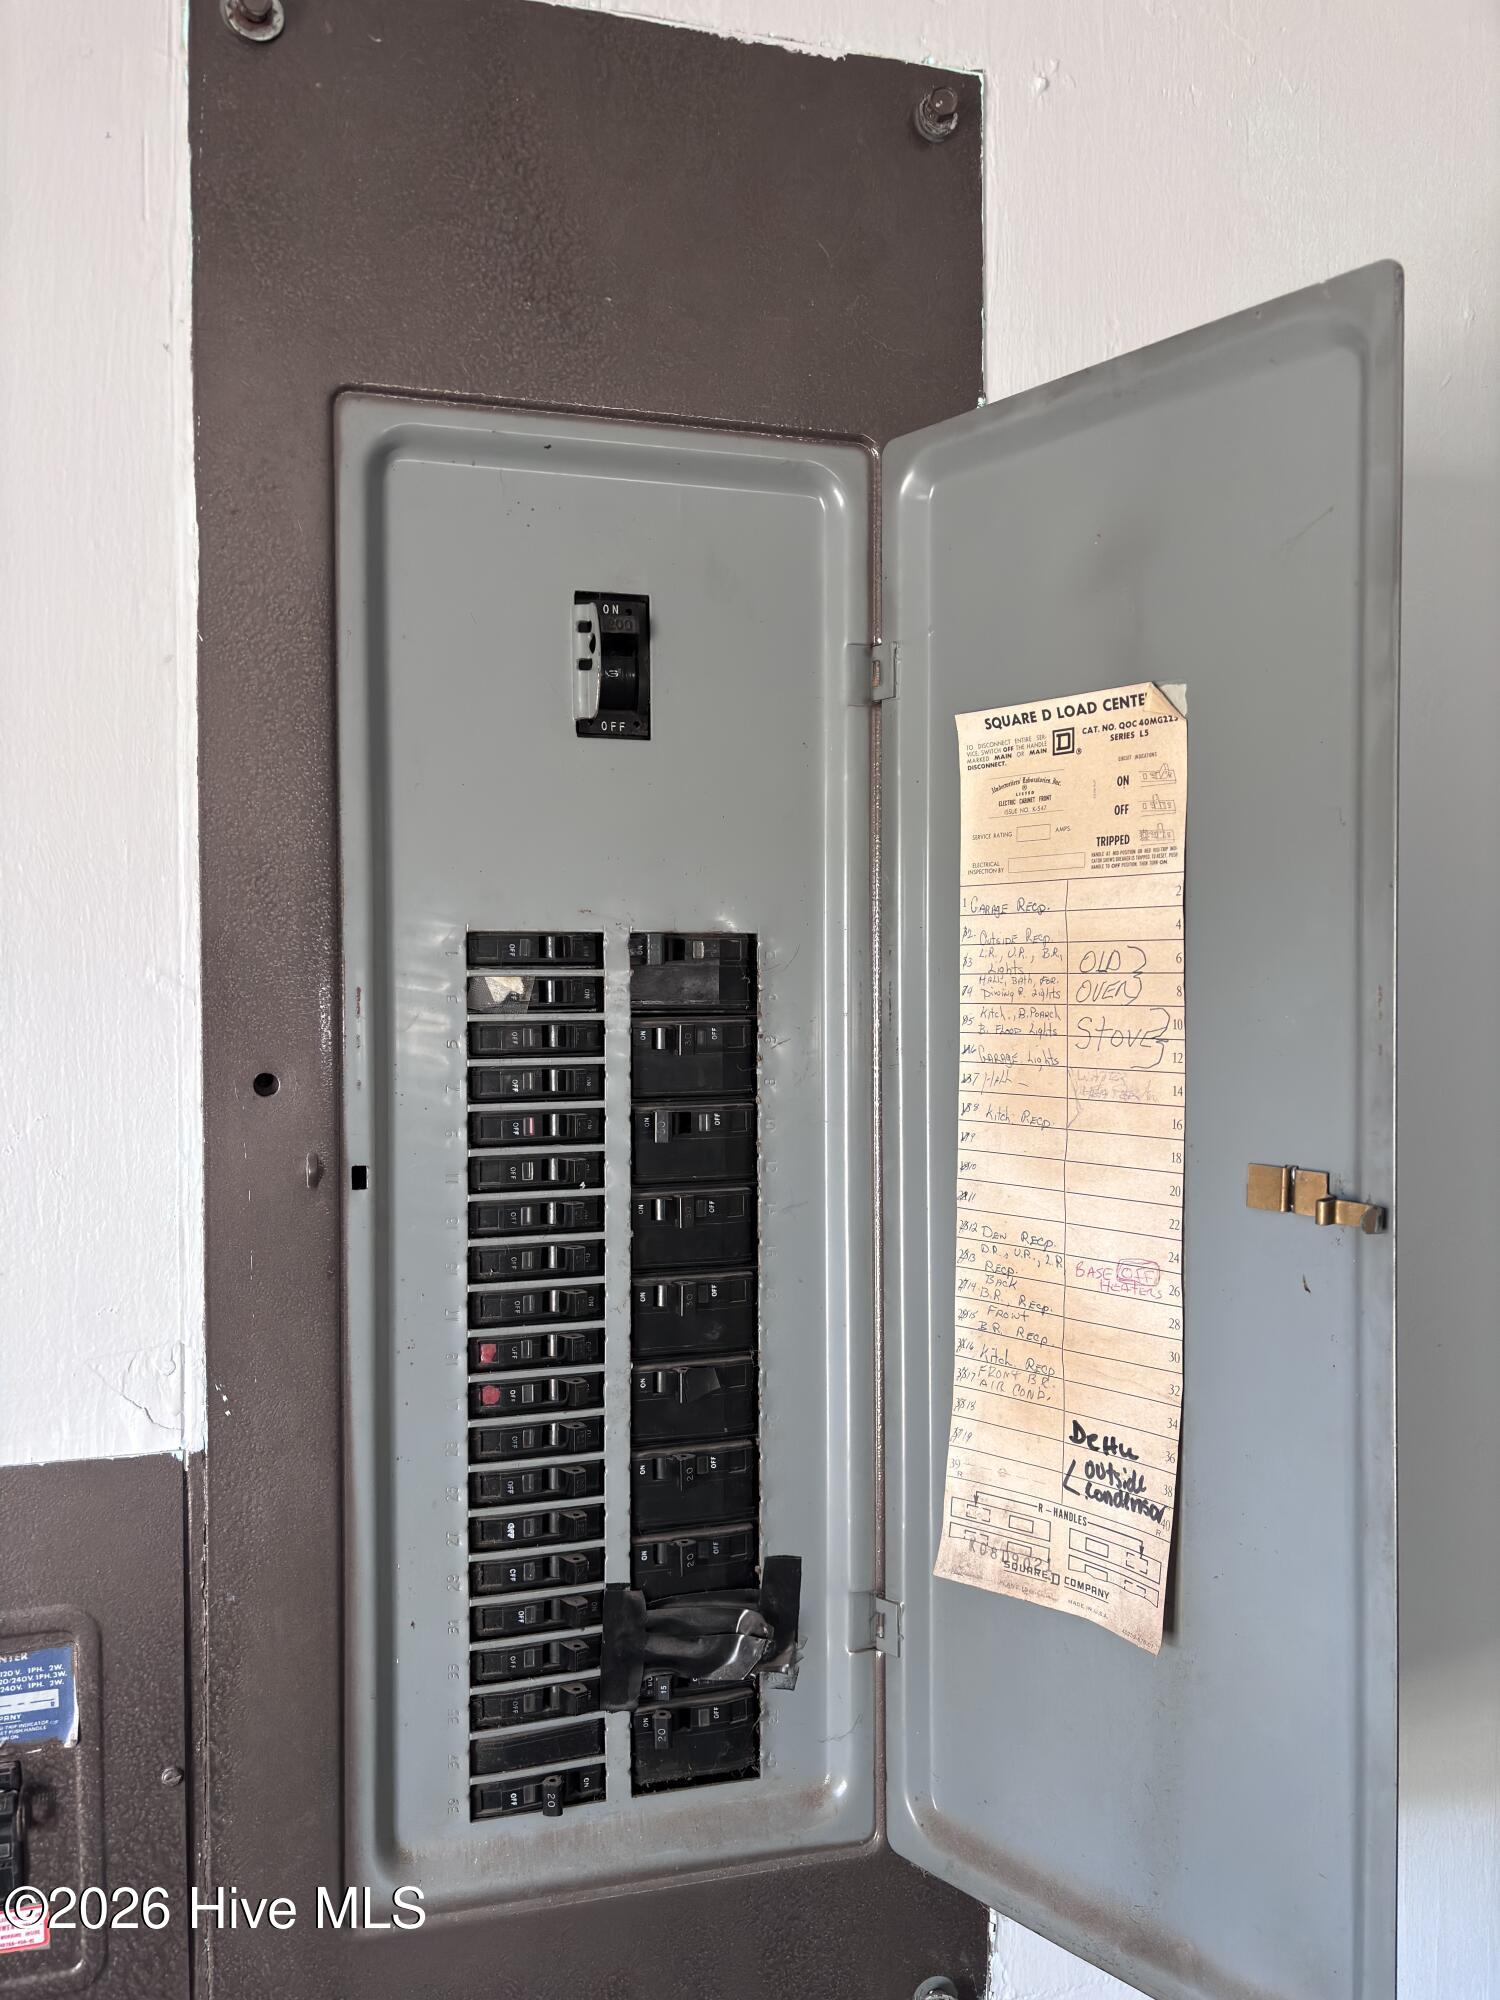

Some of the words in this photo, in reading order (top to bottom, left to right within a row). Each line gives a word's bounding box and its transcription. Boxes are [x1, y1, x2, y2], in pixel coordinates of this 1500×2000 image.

[602, 604, 619, 614] ON
[984, 711, 1037, 731] SQUARE
[1042, 709, 1052, 722] D
[1056, 701, 1098, 719] LOAD
[1102, 693, 1147, 712] CENTE
[601, 721, 626, 731] OFF
[1082, 725, 1100, 735] CAT.
[1102, 723, 1116, 732] NO.
[1118, 720, 1138, 730] QOC
[1110, 731, 1135, 742] SERIES
[1139, 729, 1149, 738] L5
[978, 739, 1011, 749] DISCONNECT
[1014, 736, 1032, 744] ENTIRE
[981, 747, 1001, 756] SWITCH
[1026, 741, 1047, 750] HANDLE
[967, 756, 990, 764] MARKED
[994, 752, 1012, 761] MAIN
[1029, 747, 1048, 756] MAIN
[967, 760, 1007, 771] DISCONNECT.
[1116, 775, 1130, 787] ON
[998, 799, 1016, 807] ELECTRIC
[1114, 804, 1129, 816] OFF
[972, 832, 992, 841] SERVICE
[993, 831, 1013, 839] RATING
[1096, 834, 1130, 847] TRIPPED
[972, 861, 1000, 869] ELECTRICAL
[968, 868, 995, 876] INSPECTION
[1175, 885, 1182, 896] 2
[1175, 919, 1182, 930] 4
[508, 943, 516, 957] OFF
[1079, 950, 1121, 974] OLD
[1175, 953, 1182, 963] 6
[1176, 986, 1182, 997] 8
[1173, 1018, 1183, 1030] 10
[511, 1031, 519, 1045] OFF
[640, 1030, 646, 1040] ON
[1172, 1052, 1183, 1063] 12
[511, 1079, 519, 1093] OFF
[1172, 1085, 1183, 1097] 14
[644, 1117, 650, 1127] ON
[1172, 1118, 1183, 1130] 16
[512, 1122, 520, 1136] OFF
[1171, 1152, 1182, 1163] 18
[1169, 1185, 1181, 1197] 20
[638, 1204, 644, 1214] ON
[1168, 1218, 1180, 1231] 22
[1168, 1252, 1180, 1263] 24
[1075, 1261, 1113, 1280] BASE
[1168, 1285, 1180, 1296] 26
[640, 1292, 646, 1302] ON
[1168, 1318, 1180, 1330] 28
[1168, 1351, 1180, 1364] 30
[640, 1378, 646, 1388] ON
[1168, 1384, 1180, 1396] 32
[1167, 1417, 1178, 1429] 34
[951, 1458, 960, 1469] 39
[1164, 1452, 1176, 1463] 36
[639, 1464, 646, 1475] ON
[686, 1467, 694, 1481] 20
[1163, 1486, 1173, 1497] 38
[1038, 1503, 1043, 1513] R
[1053, 1508, 1088, 1527] HANDLES
[641, 1550, 647, 1561] ON
[687, 1553, 694, 1568] 20
[1064, 1576, 1110, 1599] COMPANY
[509, 1655, 517, 1669] OFF
[660, 1685, 667, 1694] 15
[643, 1717, 649, 1728] ON
[657, 1728, 666, 1742] 20
[510, 1792, 518, 1806] OFF
[547, 1793, 556, 1808] 20
